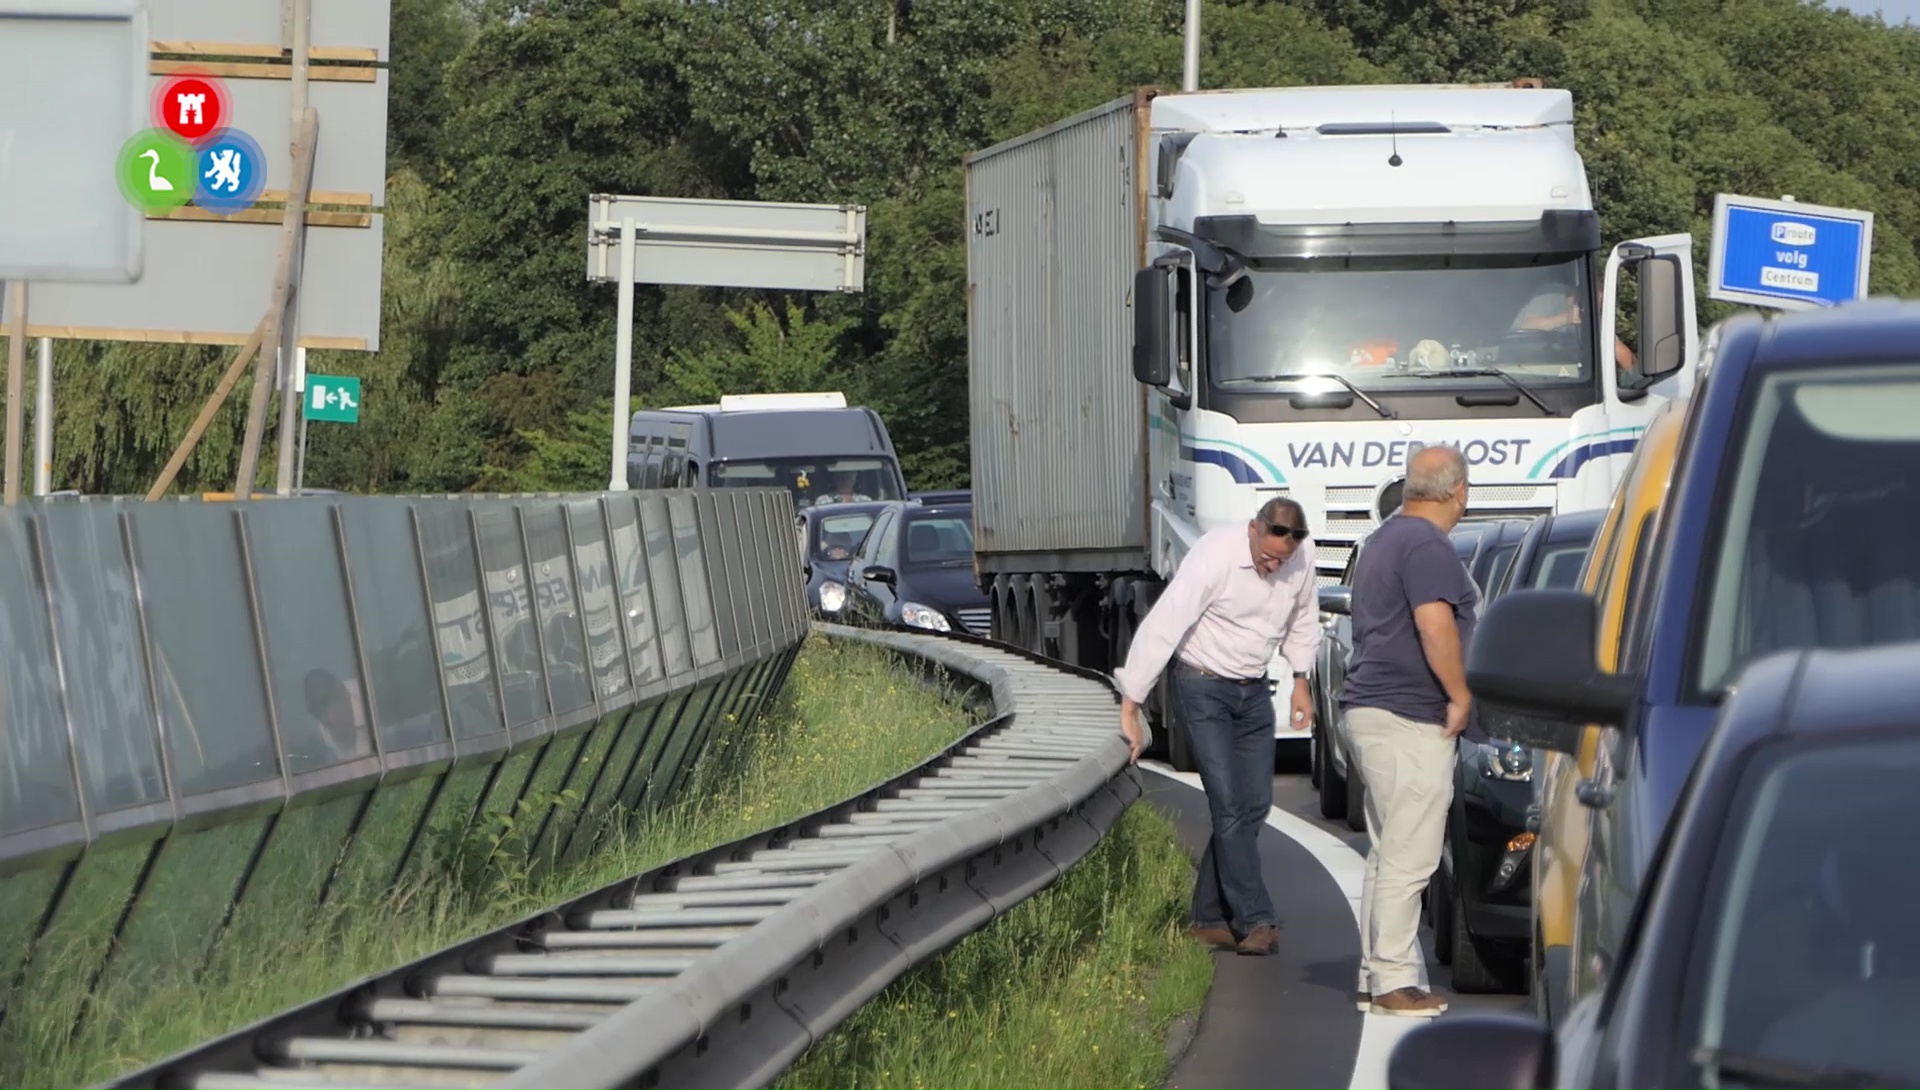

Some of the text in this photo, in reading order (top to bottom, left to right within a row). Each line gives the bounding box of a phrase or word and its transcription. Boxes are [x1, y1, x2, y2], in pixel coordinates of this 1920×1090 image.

[1775, 226, 1814, 240] P route
[1776, 250, 1808, 269] volg
[1766, 270, 1814, 286] Centrum
[1288, 441, 1355, 468] VAN
[1440, 439, 1531, 466] OST
